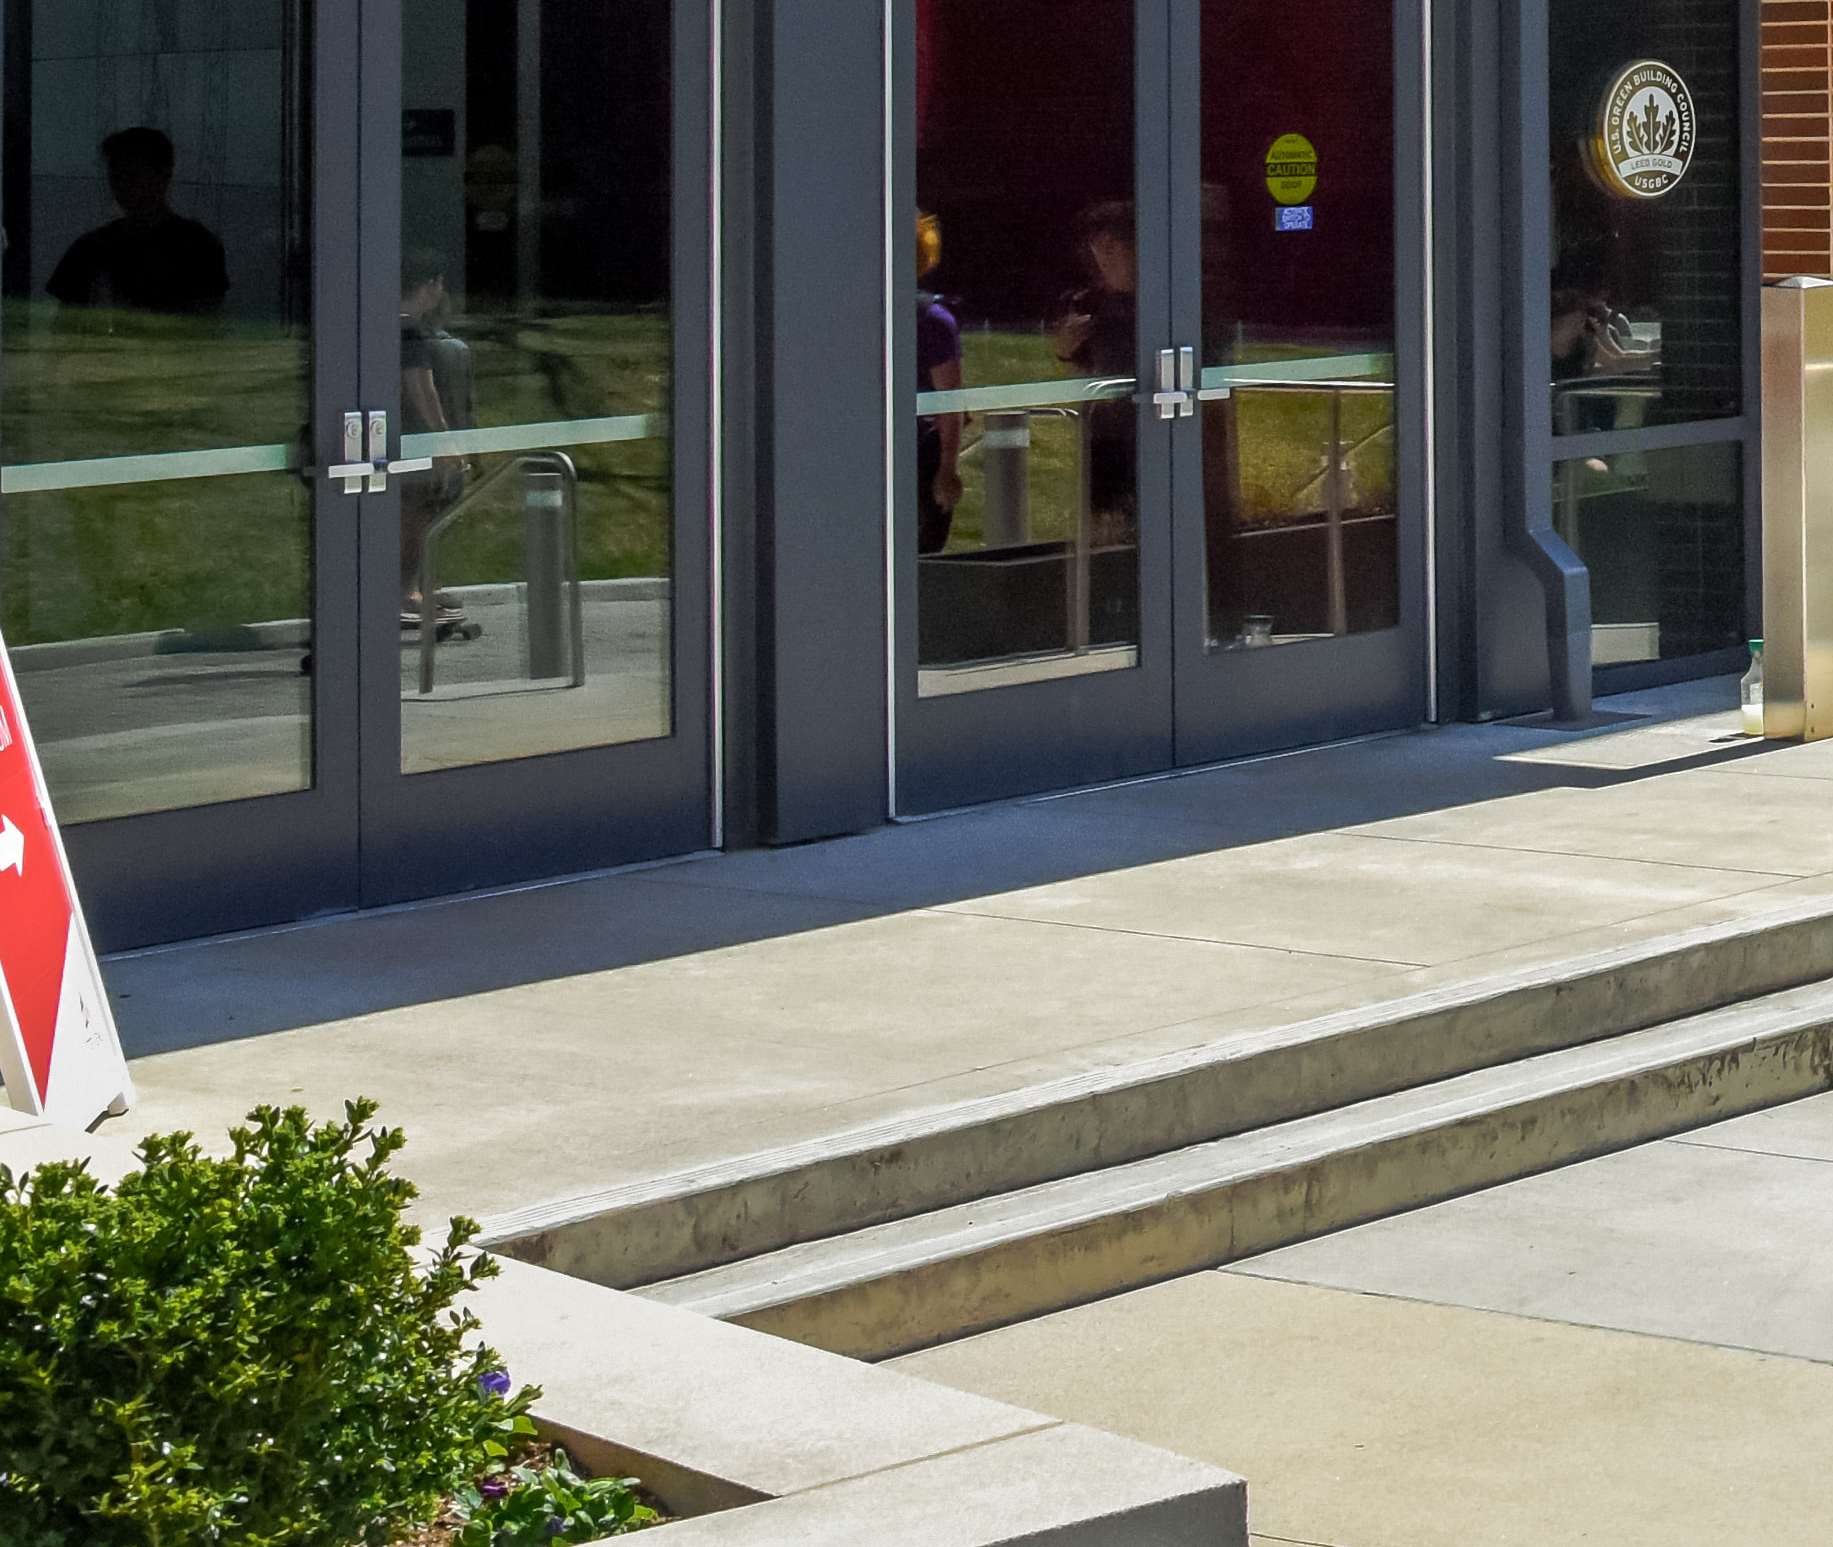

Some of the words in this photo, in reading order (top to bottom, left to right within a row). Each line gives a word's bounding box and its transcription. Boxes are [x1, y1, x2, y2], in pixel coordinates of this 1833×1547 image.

[1633, 69, 1679, 93] BUILDING
[1611, 81, 1633, 125] GREEN
[1676, 93, 1691, 153] COUNCIL
[1611, 128, 1623, 154] U.S.
[1267, 163, 1316, 176] CAUTION
[1631, 158, 1650, 170] LEED
[1651, 157, 1673, 169] GOLD
[1634, 173, 1669, 189] USGBC
